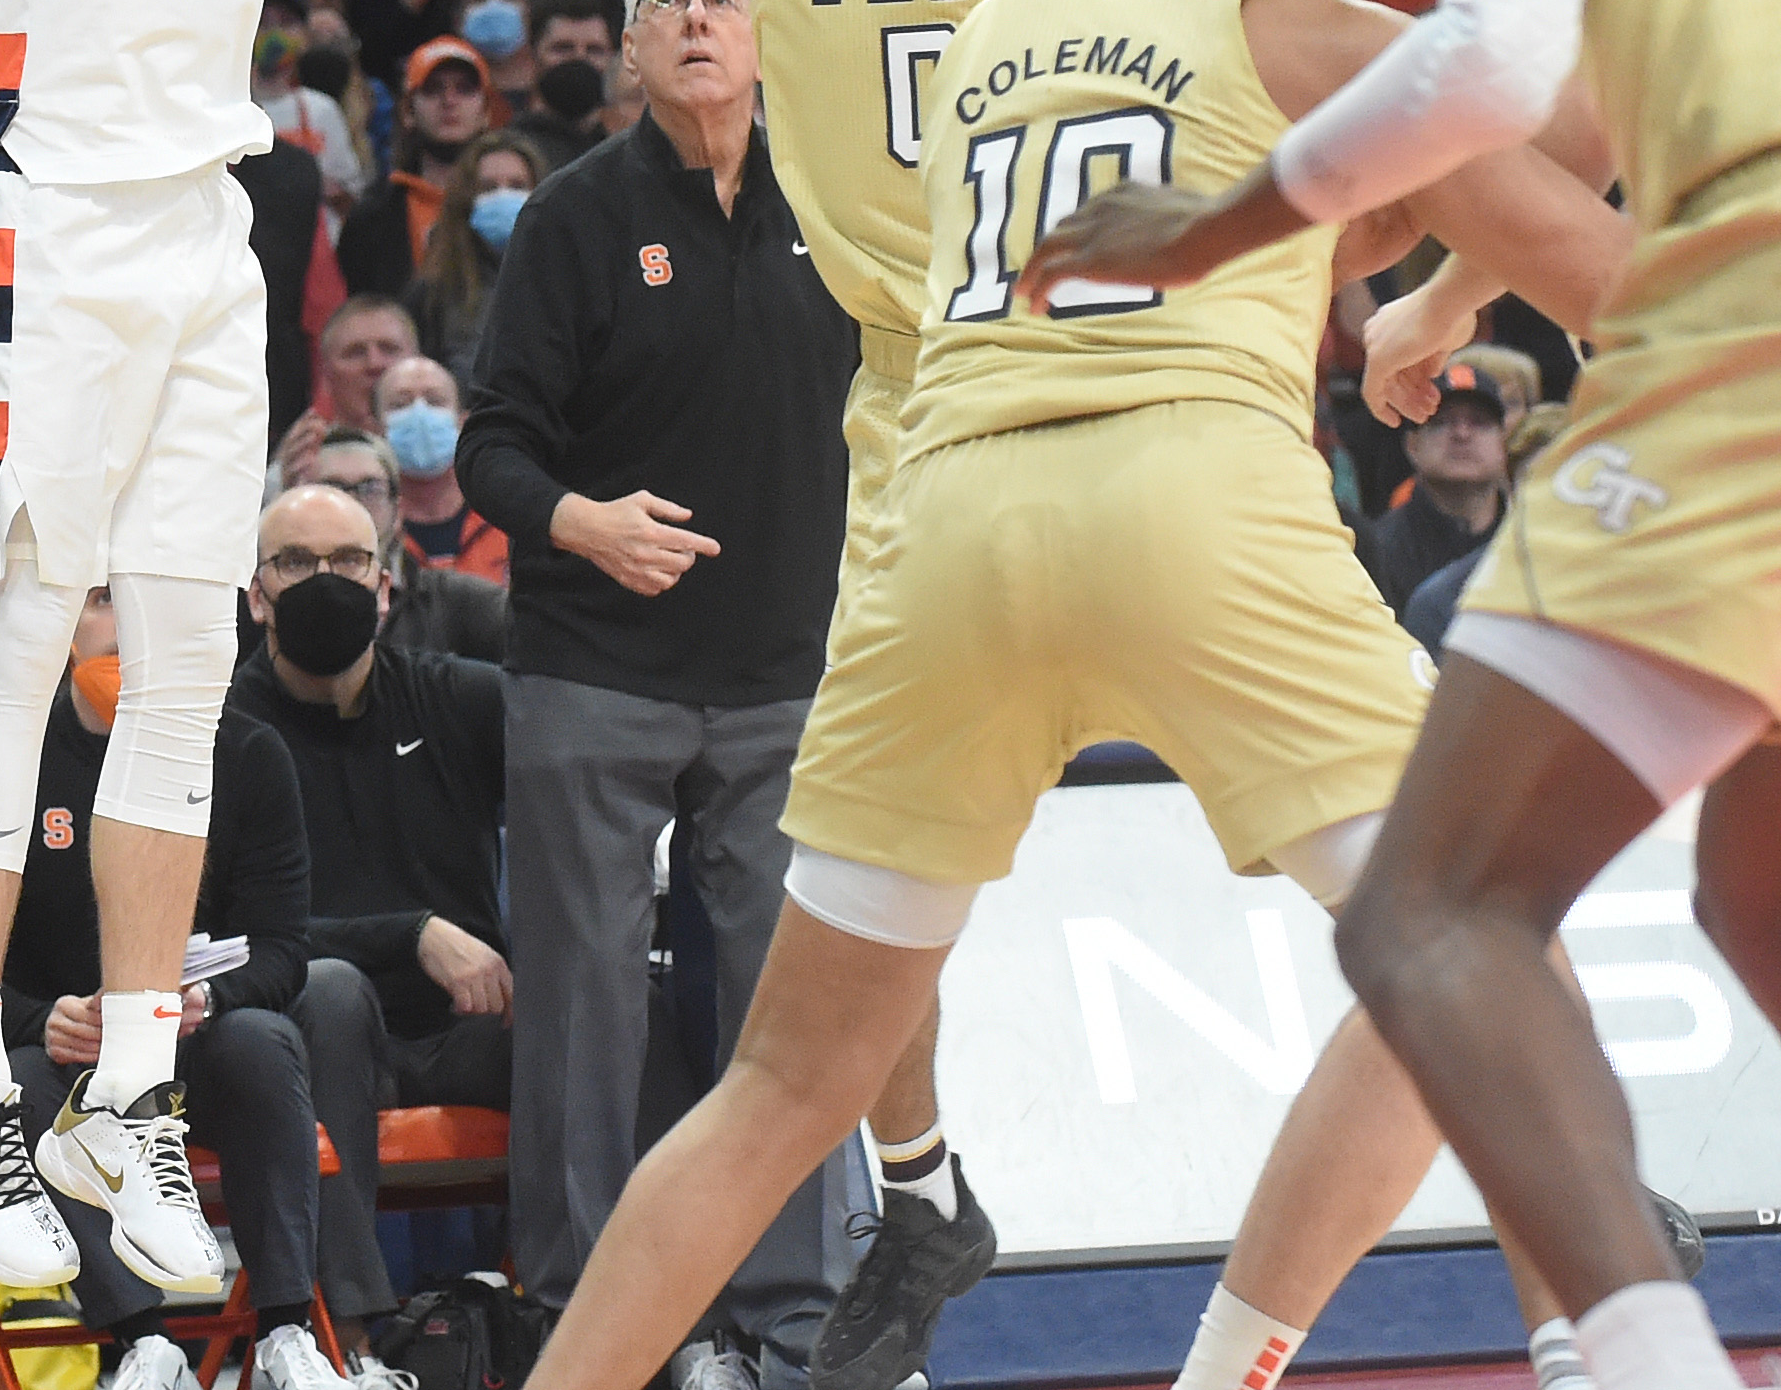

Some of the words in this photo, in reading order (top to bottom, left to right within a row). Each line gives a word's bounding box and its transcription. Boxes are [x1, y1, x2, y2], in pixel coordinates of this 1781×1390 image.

[955, 35, 1196, 125] COLEMAN
[943, 104, 1176, 323] 10
[639, 242, 674, 287] S
[41, 806, 75, 851] S
